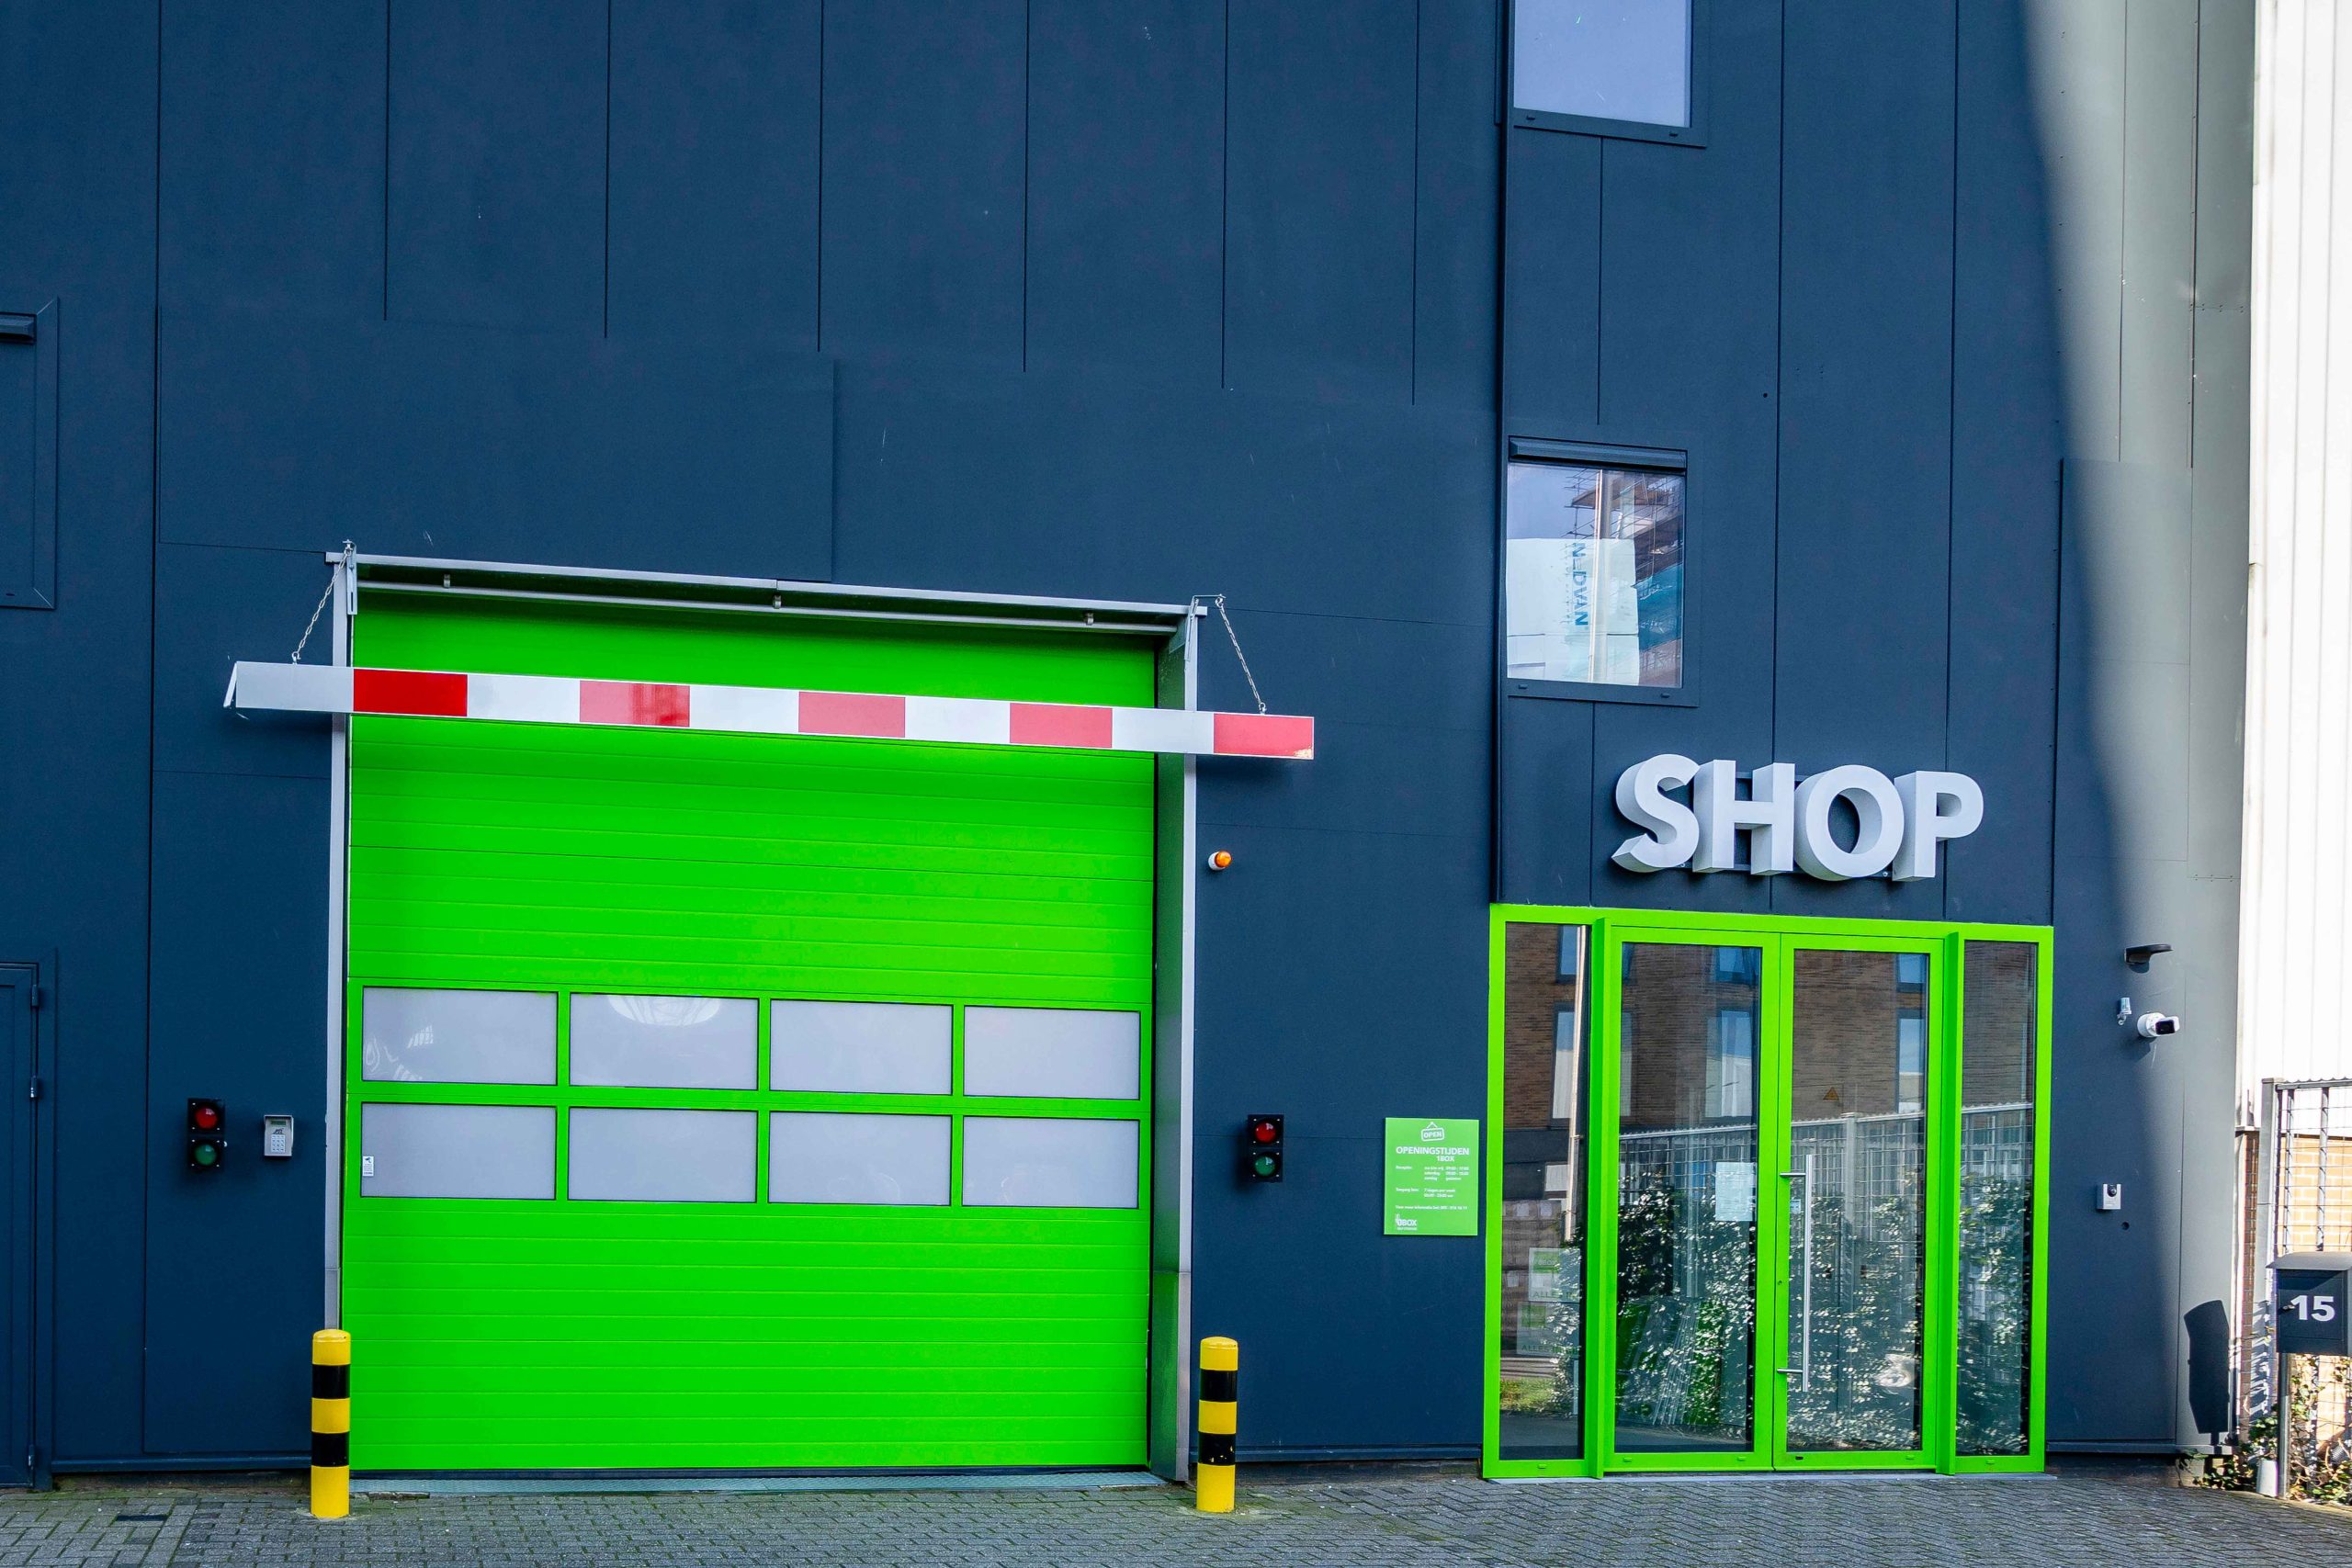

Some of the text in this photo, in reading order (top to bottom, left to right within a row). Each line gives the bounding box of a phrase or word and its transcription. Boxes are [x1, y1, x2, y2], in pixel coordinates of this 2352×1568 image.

[1611, 753, 1984, 881] SHOP
[1423, 1131, 1442, 1139] OPEN
[1396, 1146, 1470, 1155] OPENINGSTIJDEN
[2290, 1295, 2335, 1322] 15
